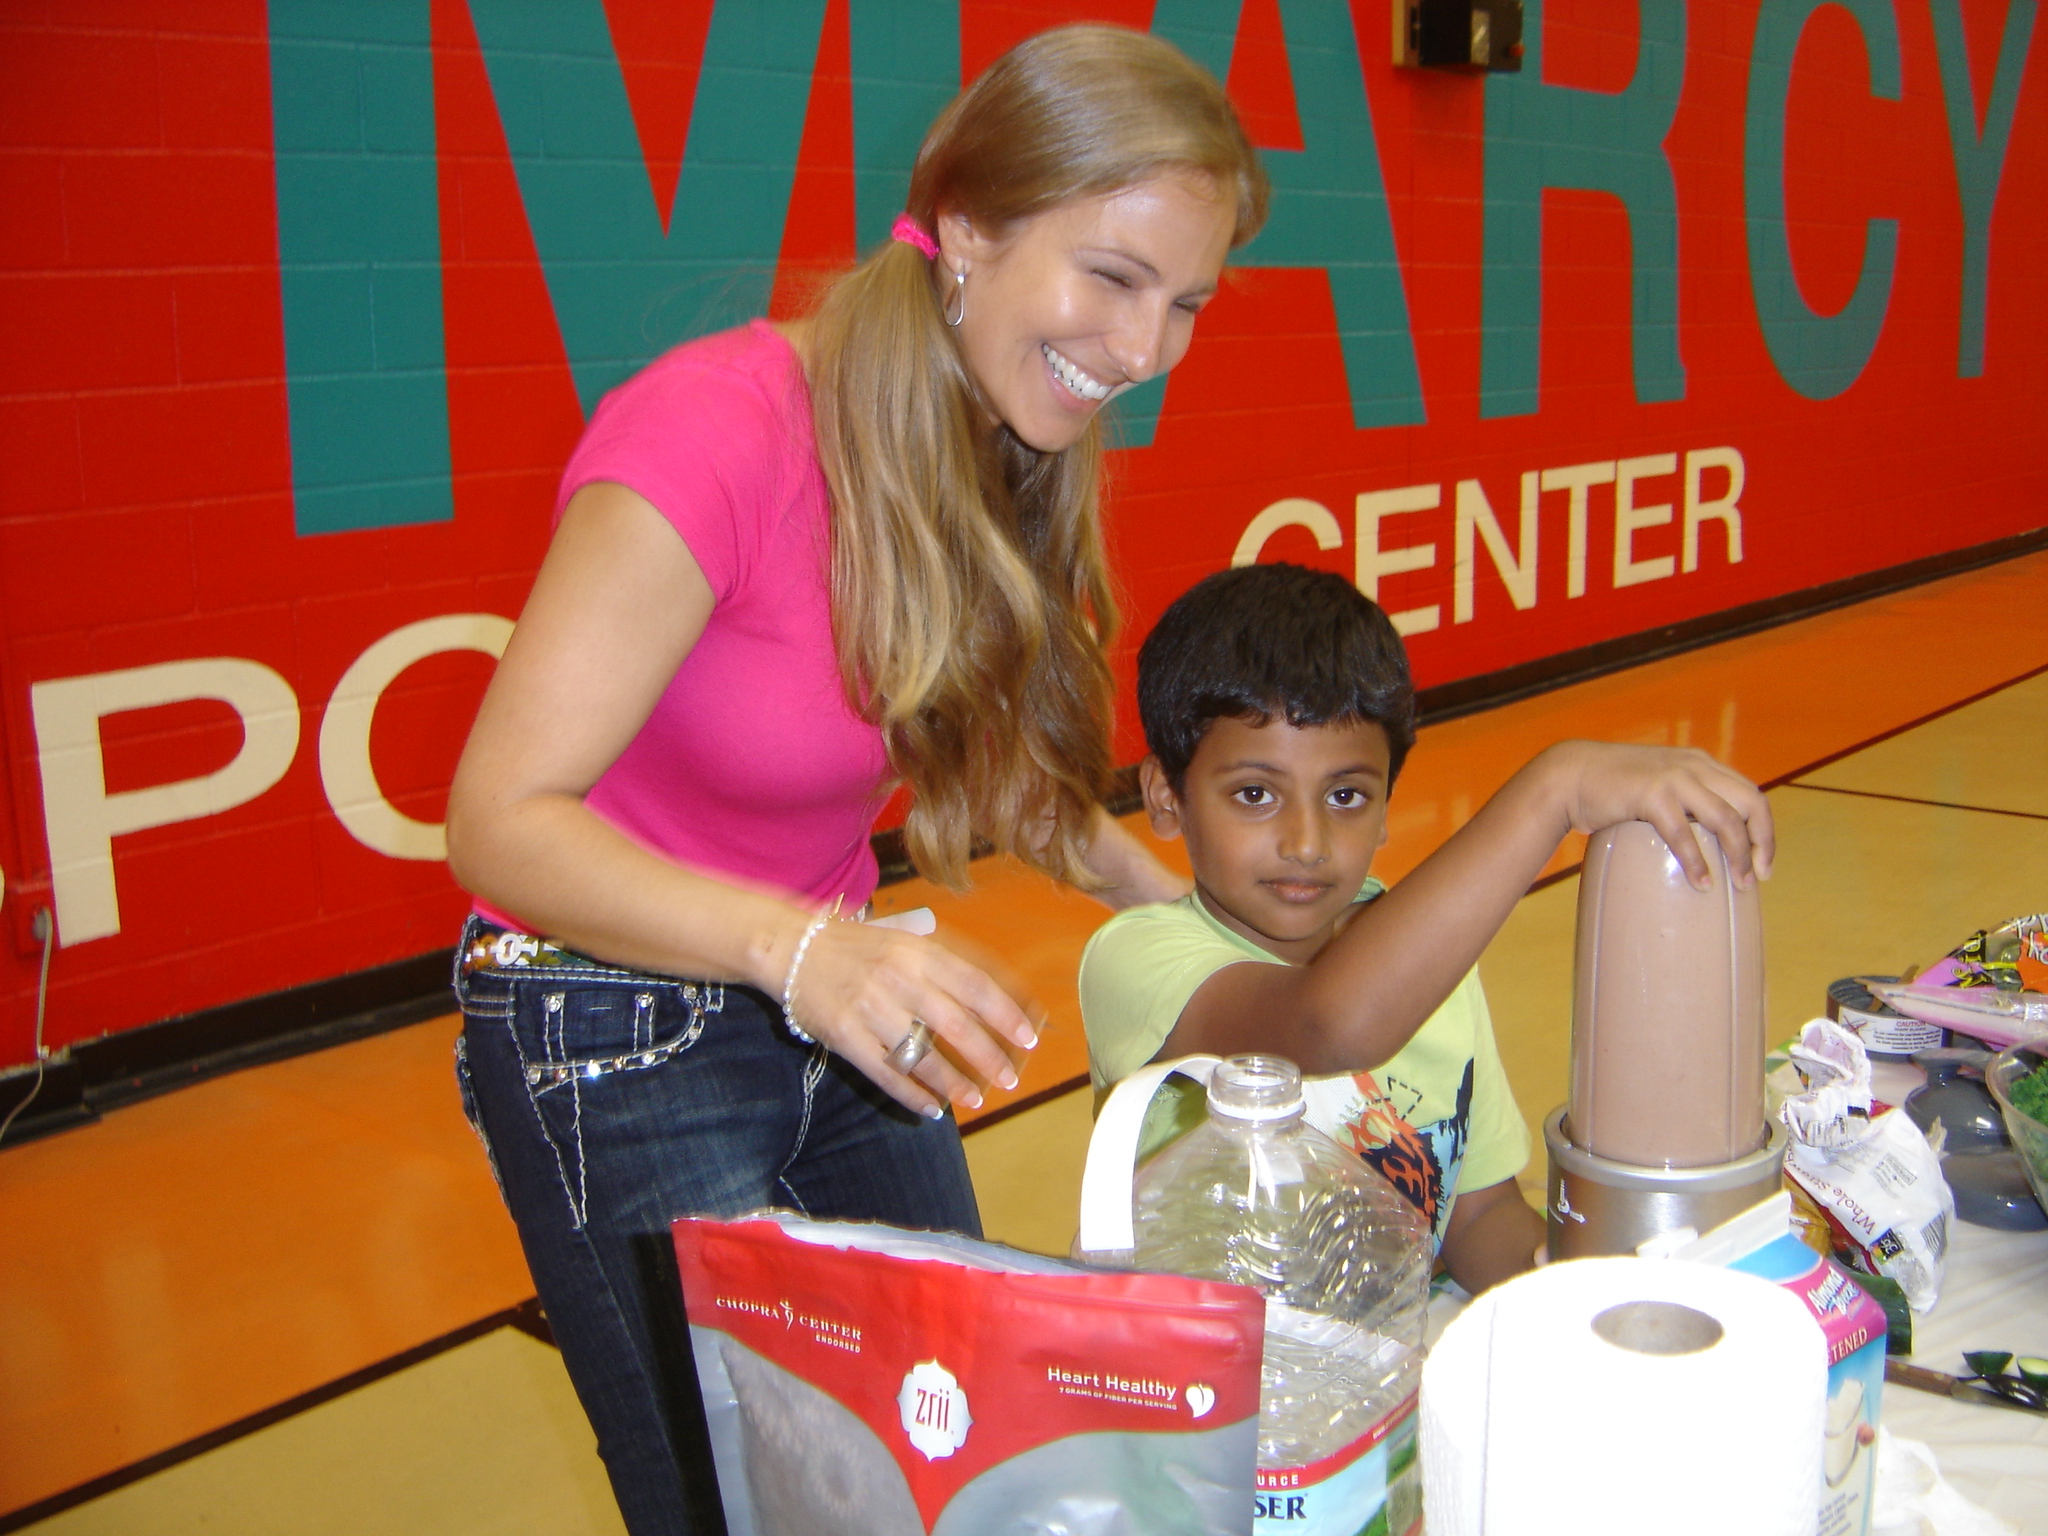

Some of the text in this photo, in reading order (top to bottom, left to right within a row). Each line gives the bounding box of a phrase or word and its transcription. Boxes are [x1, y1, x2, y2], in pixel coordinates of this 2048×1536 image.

[266, 0, 2040, 537] MARCY
[1231, 446, 1745, 634] CENTER
[1832, 1188, 1875, 1235] Whole
[1806, 1264, 1847, 1316] Almond
[716, 1296, 861, 1341] CHOPRA CENTER
[815, 1333, 861, 1353] ENDORSED
[1829, 1326, 1868, 1364] TENED
[1047, 1365, 1177, 1401] Heart Healthy
[1065, 1387, 1092, 1397] GRAMS
[1093, 1390, 1103, 1398] OF
[1104, 1393, 1127, 1403] FIBER
[1128, 1397, 1143, 1406] PER
[1144, 1399, 1177, 1410] SERVING
[915, 1387, 950, 1432] zrii
[1257, 1474, 1299, 1487] URCE
[1253, 1495, 1307, 1520] SER
